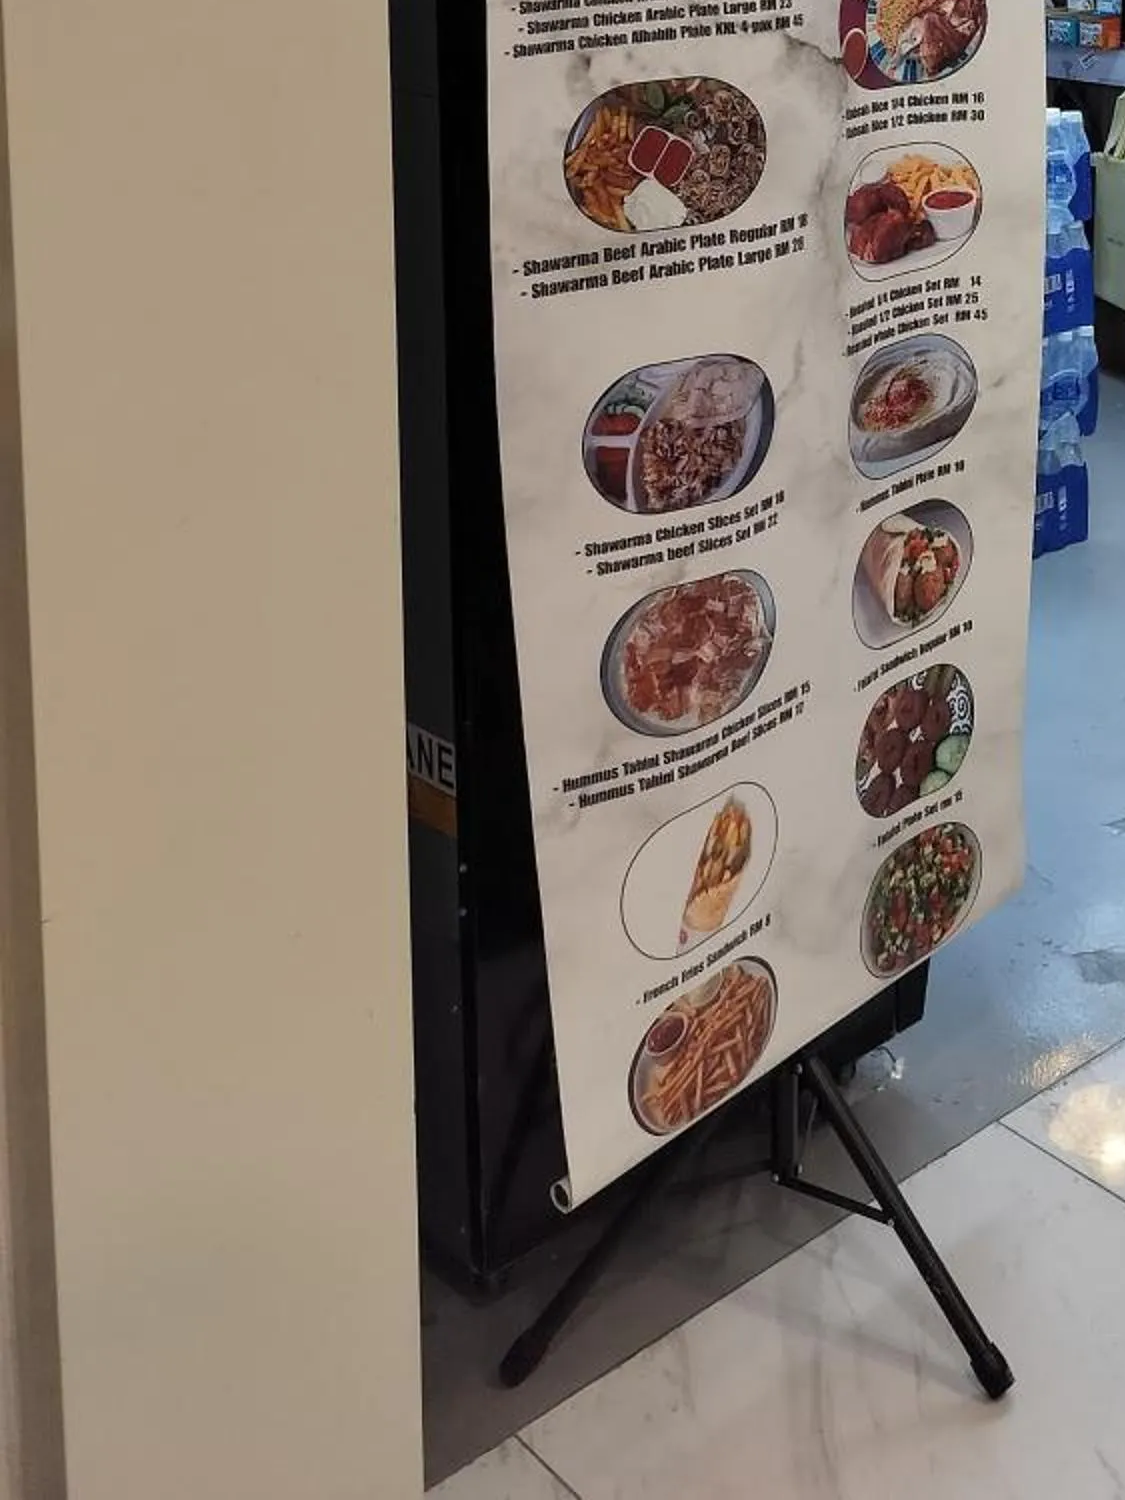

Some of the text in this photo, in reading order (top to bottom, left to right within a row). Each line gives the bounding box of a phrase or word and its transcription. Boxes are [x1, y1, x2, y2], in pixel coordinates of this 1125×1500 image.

[527, 16, 588, 35] Shawarma
[594, 10, 642, 26] Chicken
[646, 6, 685, 22] Arabic
[689, 3, 720, 17] Plate
[724, 0, 756, 15] Large
[513, 40, 574, 59] Shawarma
[578, 33, 628, 50] Chicken
[681, 24, 711, 39] Plate
[907, 111, 948, 125] Chicken
[908, 94, 948, 107] Chicken
[523, 251, 598, 276] Shawarma
[604, 243, 636, 262] Beef
[641, 237, 686, 257] Arabic
[690, 232, 725, 250] Plate
[730, 223, 777, 244] Regular
[532, 273, 608, 299] Shawarma
[612, 265, 644, 285] Beef
[650, 259, 695, 280] Arabic
[698, 252, 734, 272] Plate
[738, 245, 772, 267] Large
[925, 279, 940, 293] Set
[928, 296, 942, 309] Set
[933, 313, 949, 325] Set
[584, 503, 759, 557] Shawarma Chicken Slices Set
[597, 526, 751, 576] Shawarma beef Slices Set
[562, 765, 619, 793] Hummus
[622, 754, 659, 777] Tahini
[663, 732, 719, 764] Shawarma
[578, 781, 634, 809] Hummus
[639, 769, 675, 791] Tahini
[678, 747, 728, 779] Shawarma
[643, 976, 678, 1003] French
